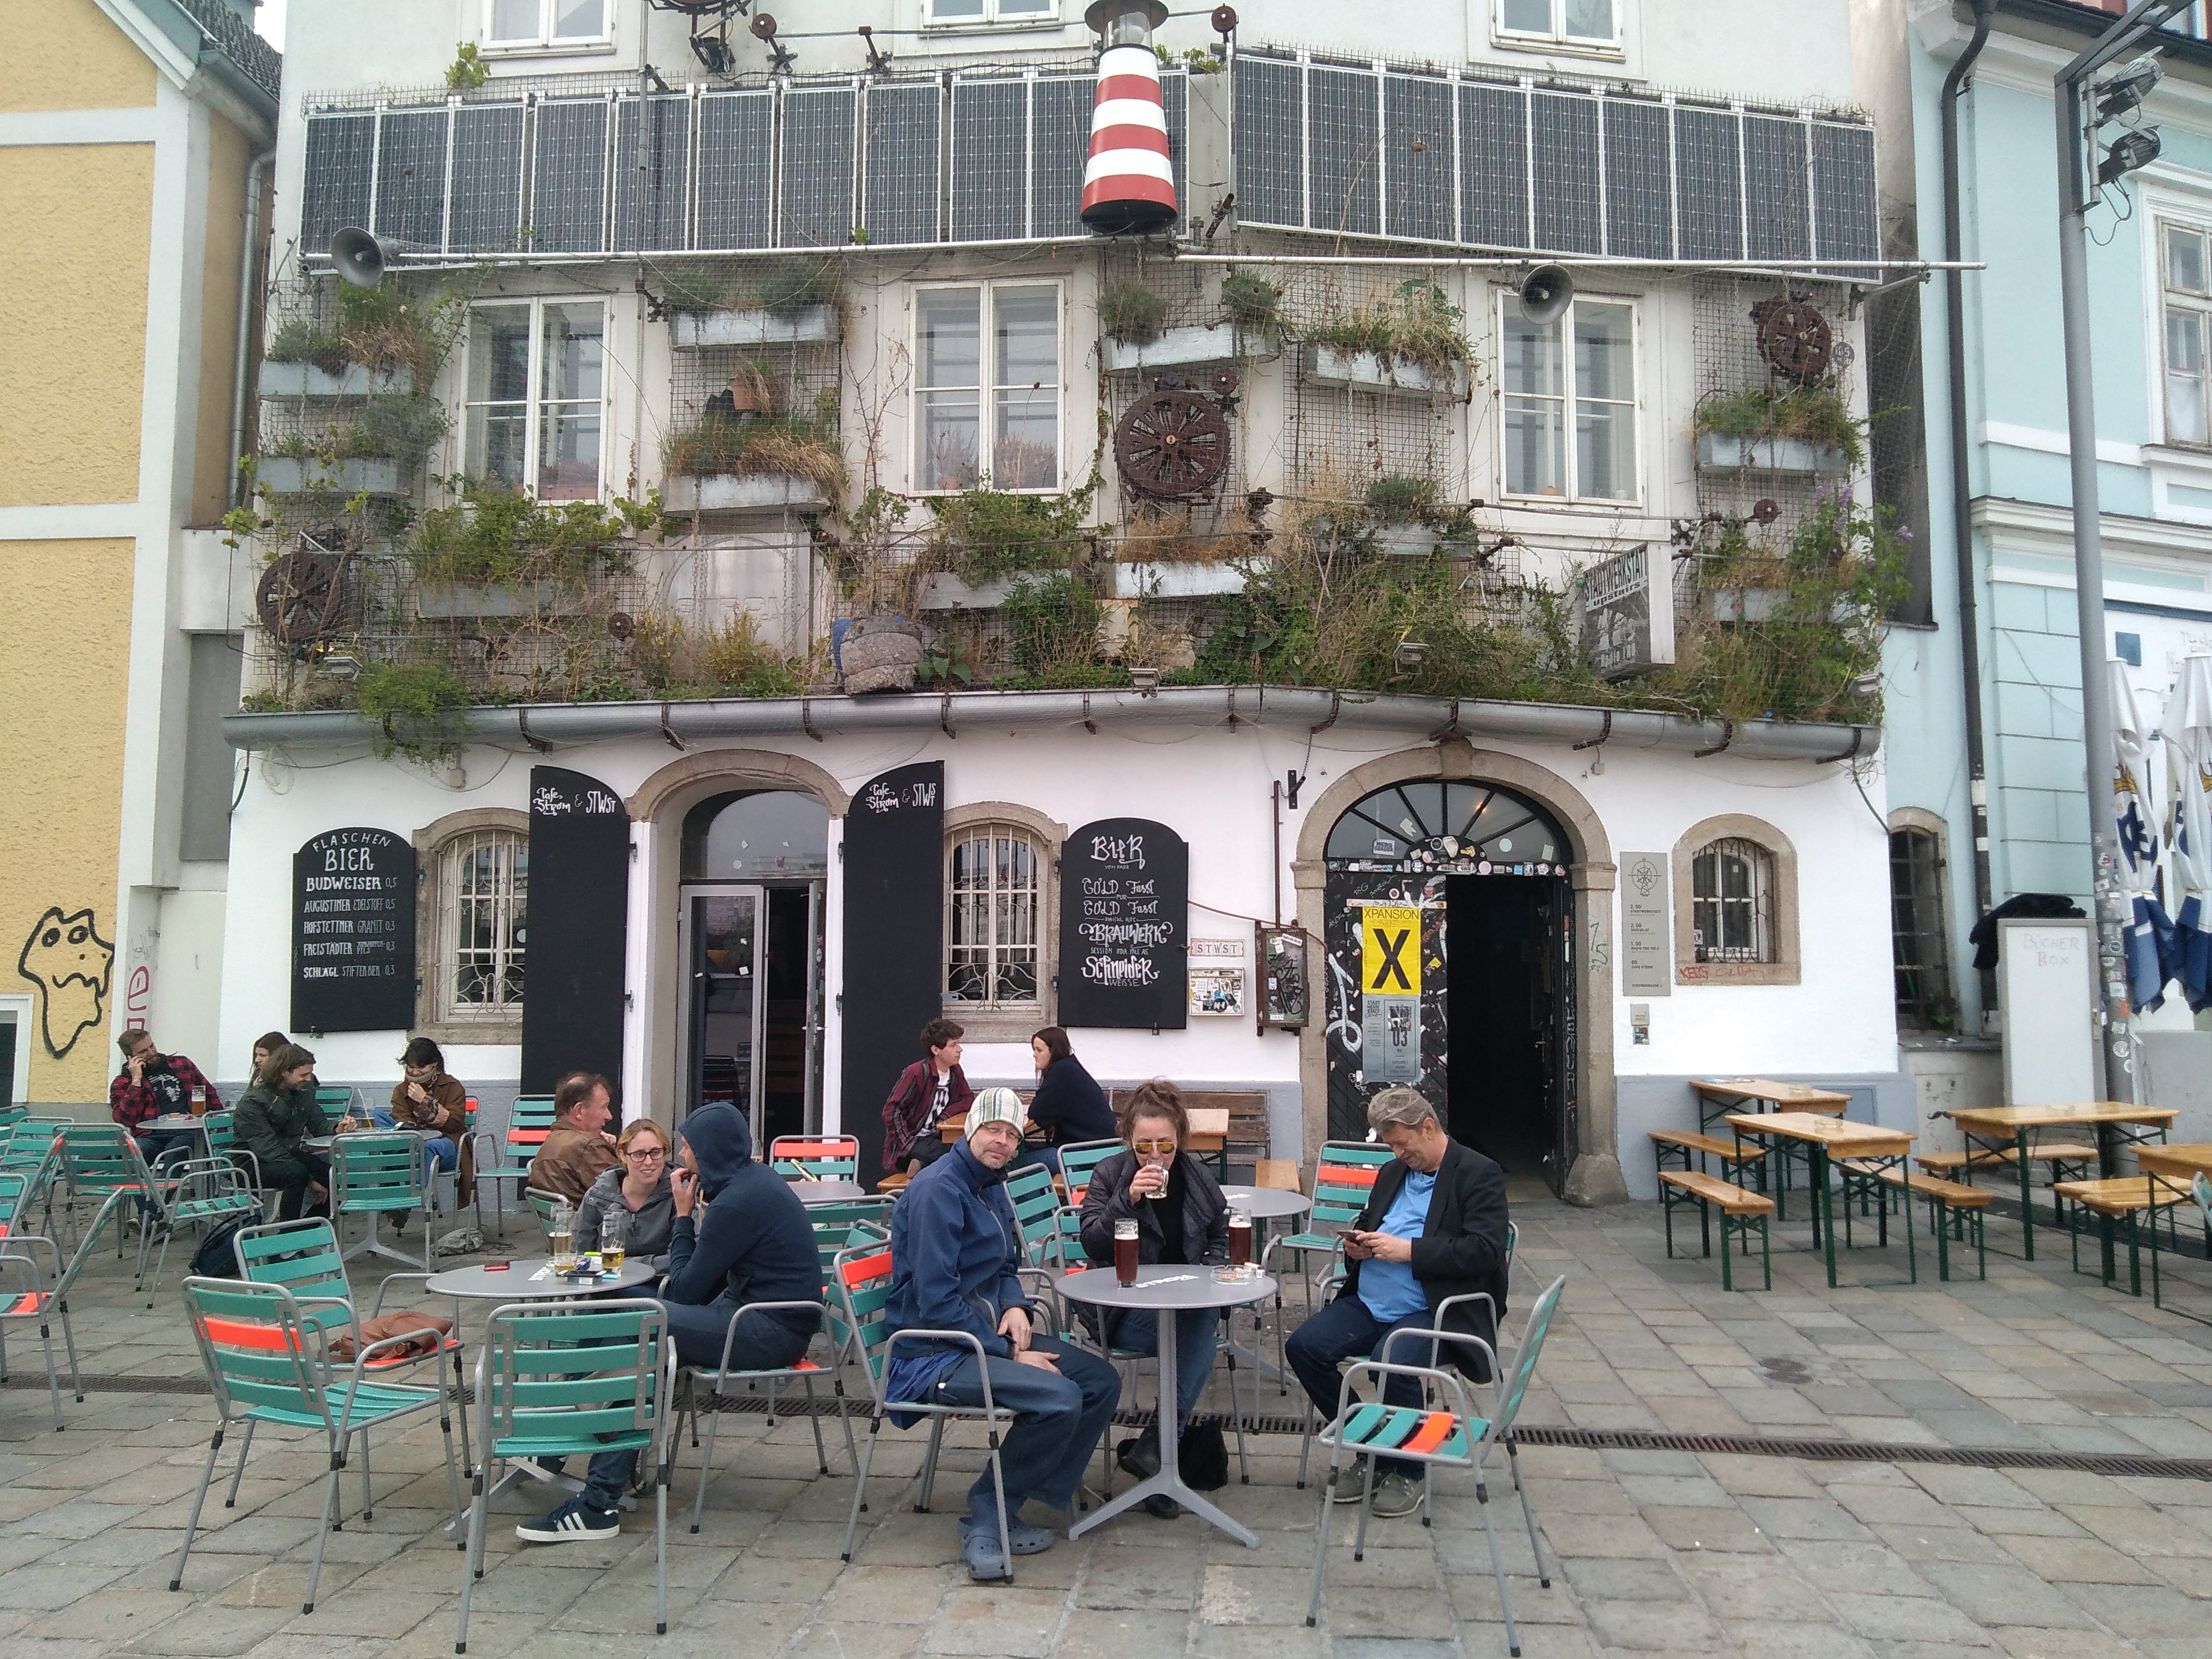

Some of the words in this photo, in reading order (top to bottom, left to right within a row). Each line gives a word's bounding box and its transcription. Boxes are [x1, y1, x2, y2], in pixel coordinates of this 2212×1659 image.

[1593, 581, 1640, 606] upstairs
[574, 794, 583, 807] &
[585, 791, 616, 813] STWST
[902, 788, 910, 803] &
[312, 832, 391, 852] FLASCHEN
[325, 847, 374, 872] BIER
[306, 876, 382, 892] BUDWEISER
[385, 877, 397, 889] 0,5
[1082, 877, 1119, 895] GOLD
[304, 899, 351, 913] AUGUSTINER
[353, 898, 383, 911] EDELSTOFF
[386, 899, 396, 909] 0,5
[1083, 900, 1120, 916] GOLD
[1364, 908, 1419, 920] XPANSION
[304, 920, 354, 934] HOFSTETTNER
[357, 920, 383, 933] GRANIT
[386, 920, 395, 931] 0,3
[1078, 921, 1173, 948] BRAUWERK
[304, 942, 353, 956] FREISTÄDTER
[1197, 943, 1237, 953] STWST
[2023, 934, 2079, 950] BÜCHER
[1372, 928, 1412, 990] X
[304, 967, 339, 978] SCHLÄGL
[385, 965, 395, 976] 0,3
